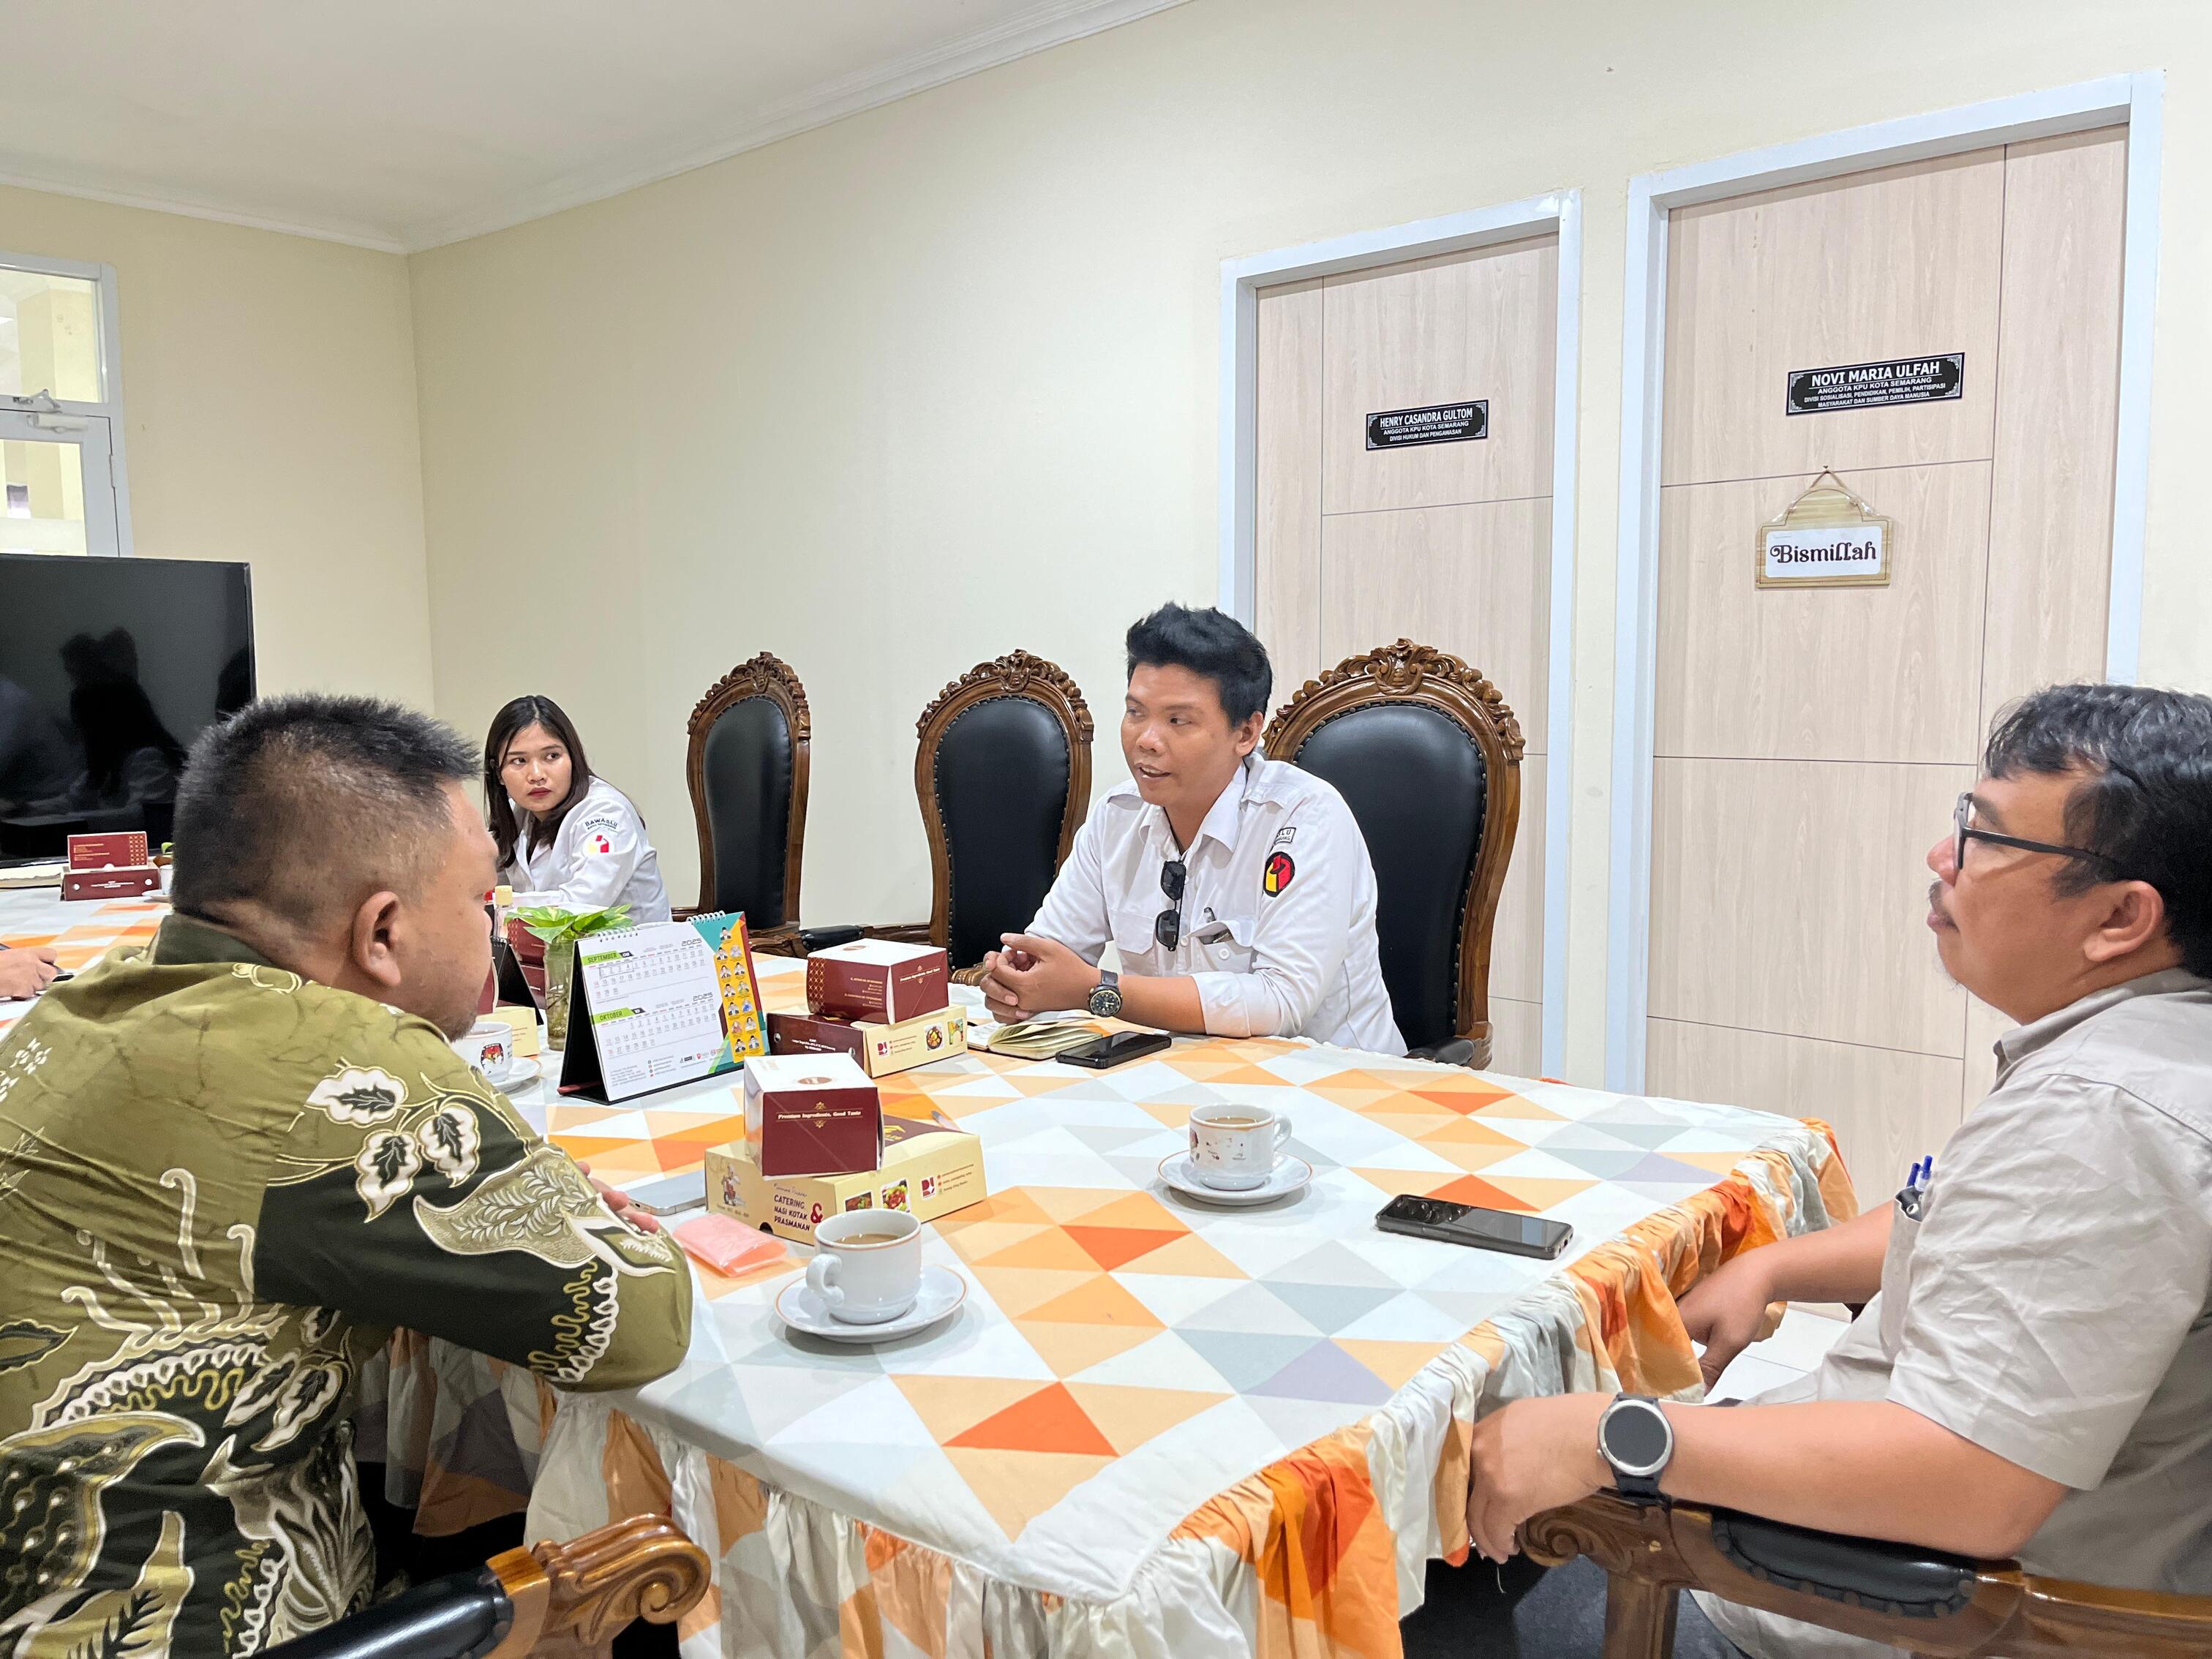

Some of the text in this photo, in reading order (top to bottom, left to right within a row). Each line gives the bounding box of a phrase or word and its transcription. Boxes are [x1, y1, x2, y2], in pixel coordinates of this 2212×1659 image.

[1812, 361, 1939, 387] NOVI MARIA ULFAH
[1818, 386, 1852, 394] ANGGOTA
[1890, 377, 1932, 387] SEMARANG
[1912, 383, 1946, 391] PARTISIPASI
[1818, 399, 1853, 407] MASYARAKAT
[1905, 391, 1930, 399] MANUSIA
[1380, 407, 1472, 428] HENRY CASANDRA GULTOM
[1437, 421, 1469, 429] SEMARANG
[1429, 429, 1462, 437] PENGAWASAN
[1770, 541, 1876, 563] Bismillah
[682, 938, 702, 947] 2025
[587, 952, 617, 963] SEPTEMBER
[693, 992, 713, 1001] 2025
[600, 1011, 622, 1021] OKTOBER
[774, 1206, 808, 1220] NASI KOTAK
[810, 1203, 823, 1224] &
[774, 1216, 810, 1231] PRASMANAN
